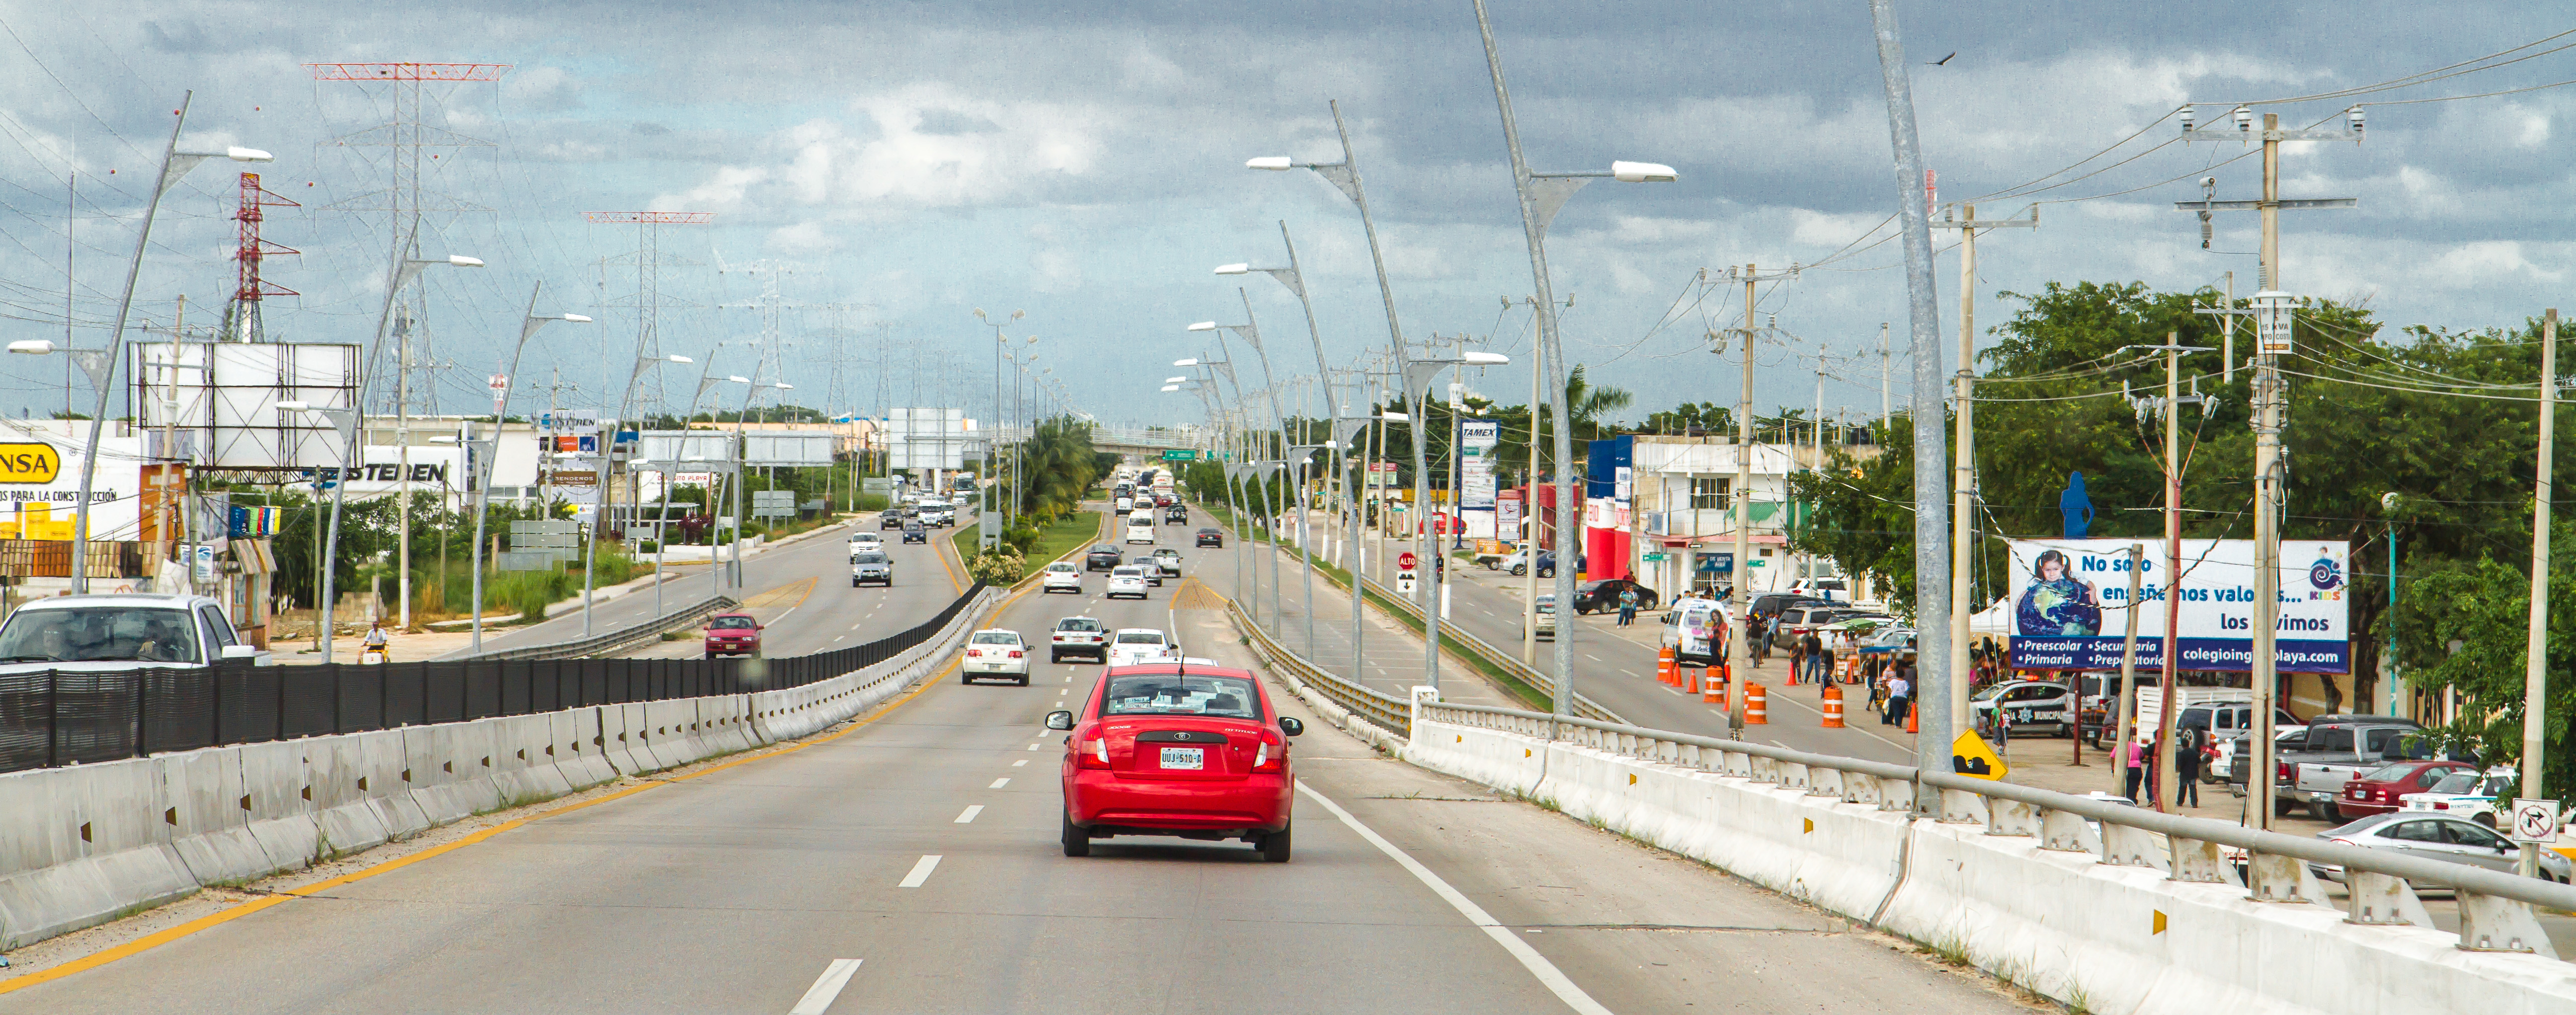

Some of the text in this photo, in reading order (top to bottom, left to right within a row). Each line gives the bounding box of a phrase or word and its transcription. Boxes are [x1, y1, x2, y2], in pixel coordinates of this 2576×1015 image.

[0, 454, 50, 473] NSA
[11, 491, 35, 501] PARA
[39, 491, 50, 501] LA
[53, 488, 117, 501] CONSTCCIÓN
[1400, 557, 1415, 565] ALTO
[2082, 556, 2151, 571] No soo
[2103, 584, 2301, 603] eneñaos valos...
[2310, 591, 2340, 601] KIDS
[2221, 613, 2329, 631] los vimos
[2024, 640, 2157, 652] Preescolar Secunaria
[2024, 654, 2164, 667] Primaria Prepatoria
[2183, 648, 2338, 665] colegioinglaya.com
[2034, 711, 2062, 720] MUNICIPA
